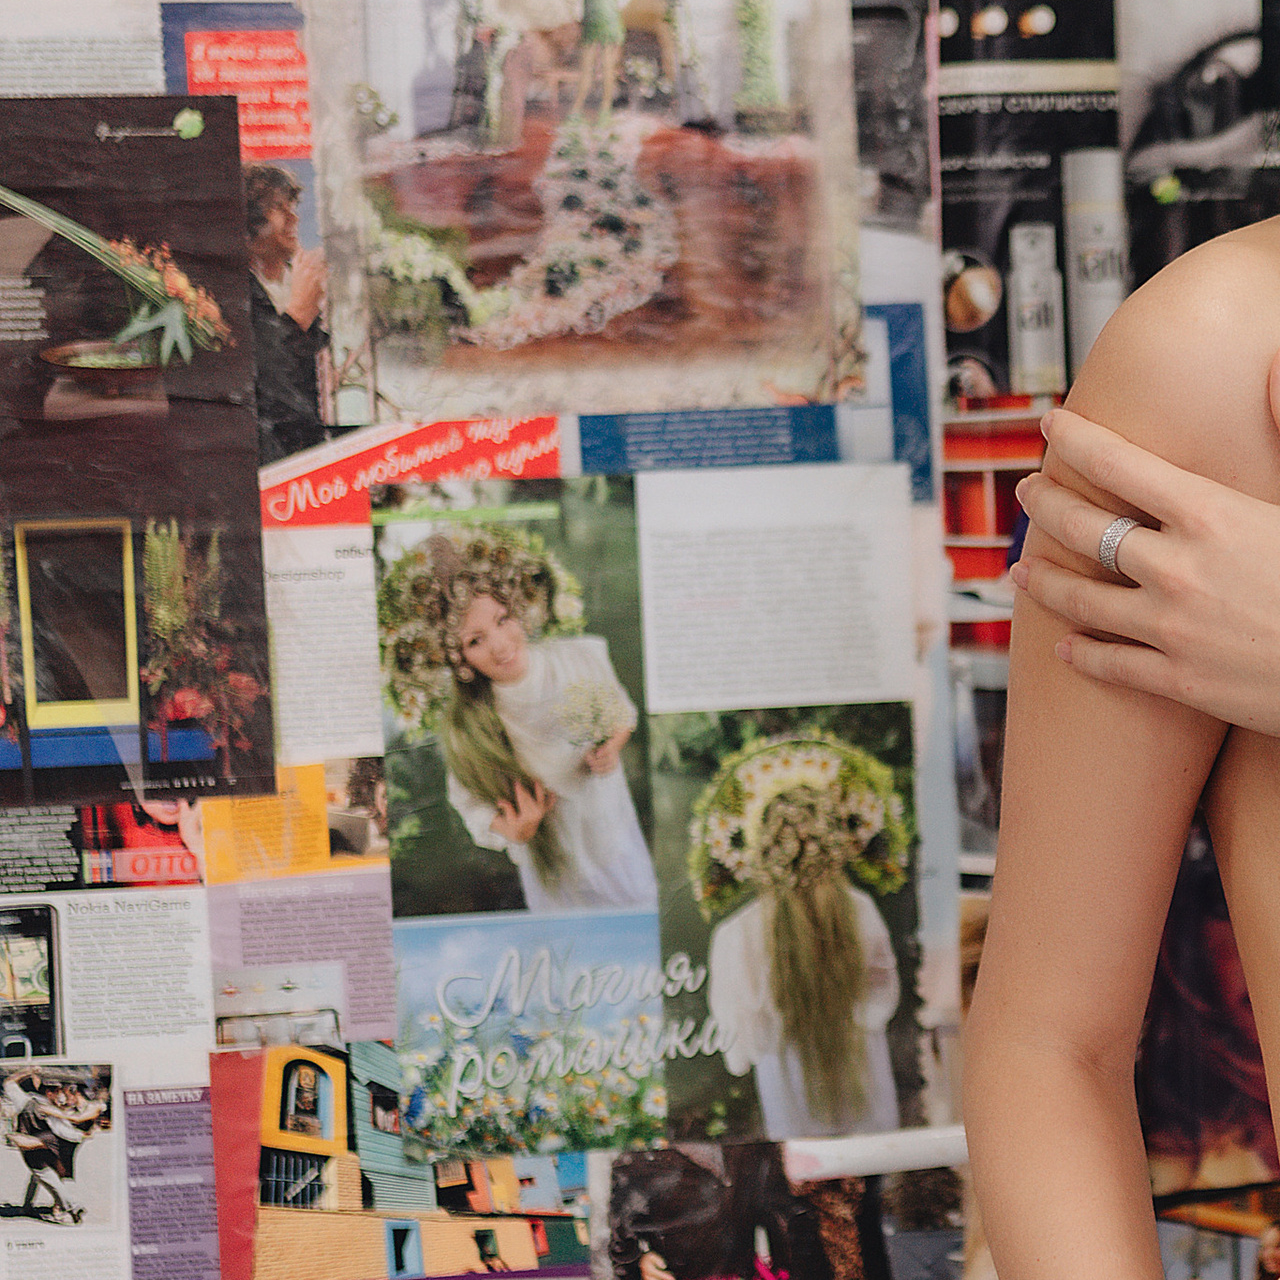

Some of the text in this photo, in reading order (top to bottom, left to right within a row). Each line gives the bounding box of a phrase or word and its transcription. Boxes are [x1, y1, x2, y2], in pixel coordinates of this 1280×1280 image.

[267, 475, 347, 522] Мой
[130, 851, 199, 877] OTTO
[67, 898, 192, 916] Nokia NaviGame
[436, 948, 706, 1029] Магия
